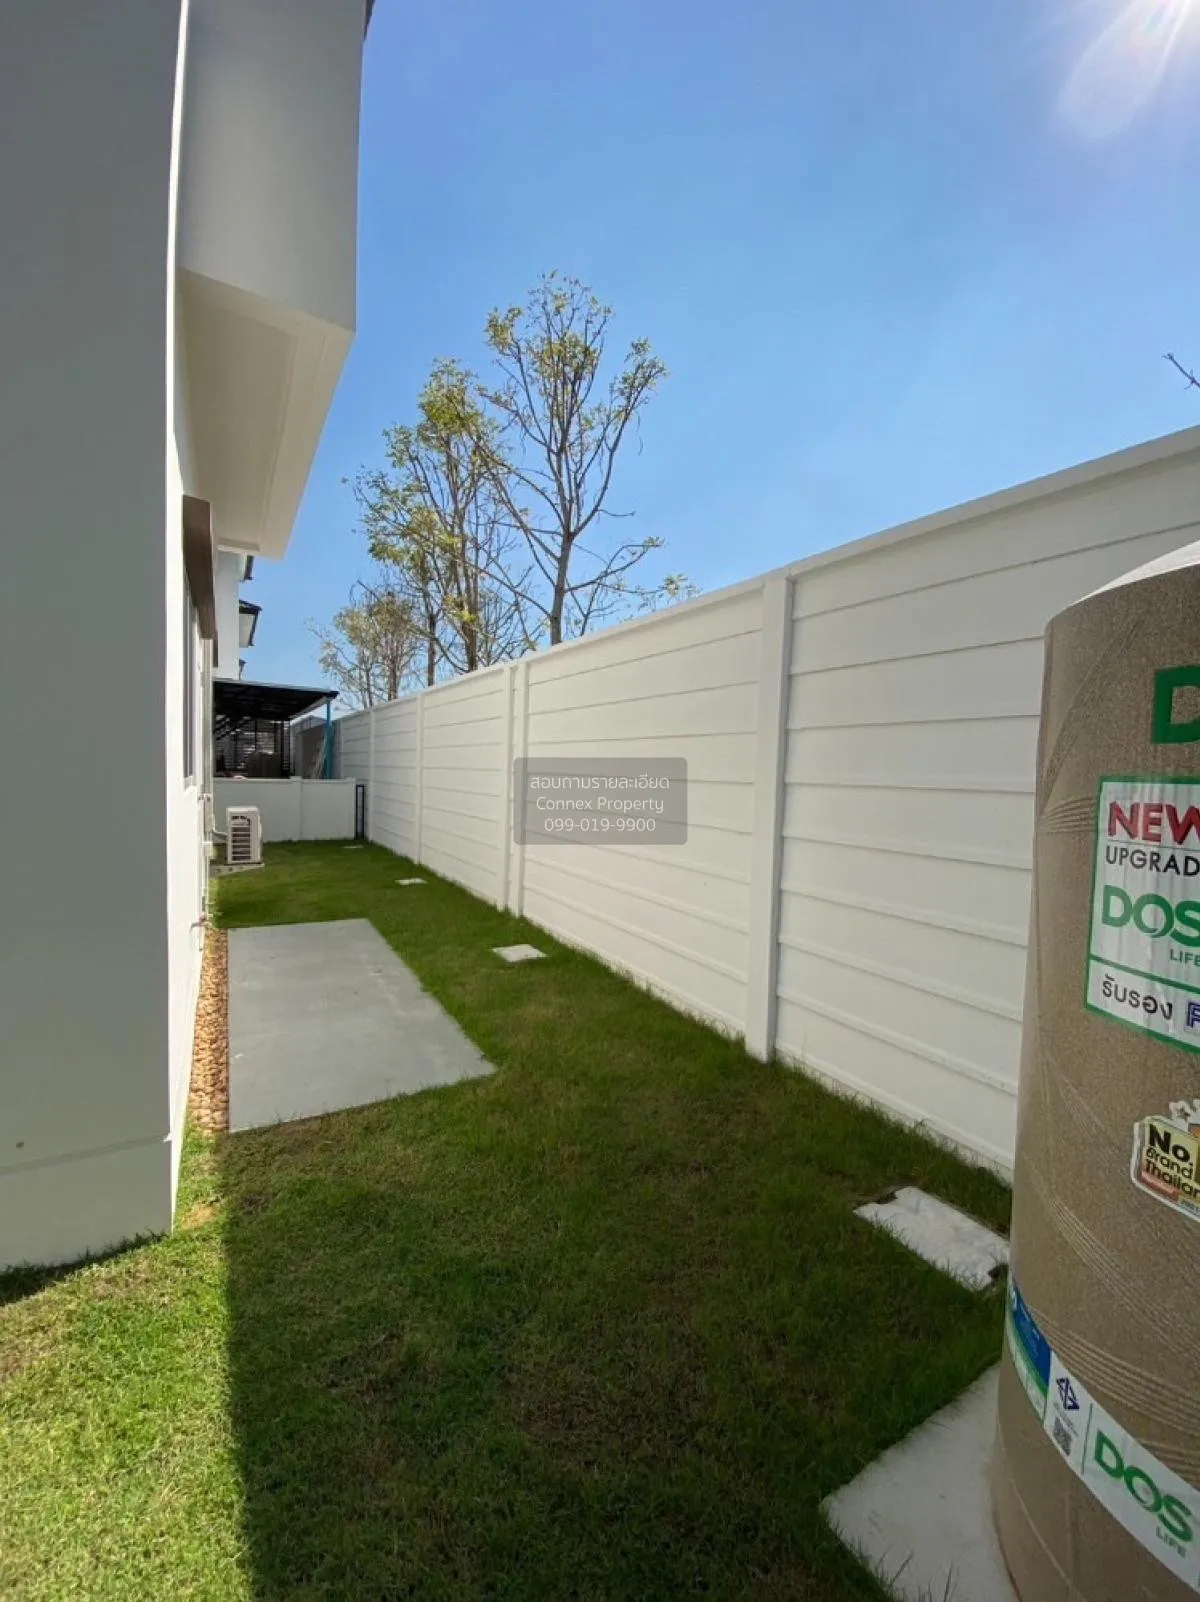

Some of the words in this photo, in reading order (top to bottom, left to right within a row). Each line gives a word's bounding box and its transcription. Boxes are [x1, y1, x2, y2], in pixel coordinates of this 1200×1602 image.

[1107, 801, 1200, 846] NEW
[1101, 884, 1200, 947] DOS
[1094, 1430, 1192, 1543] DOS
